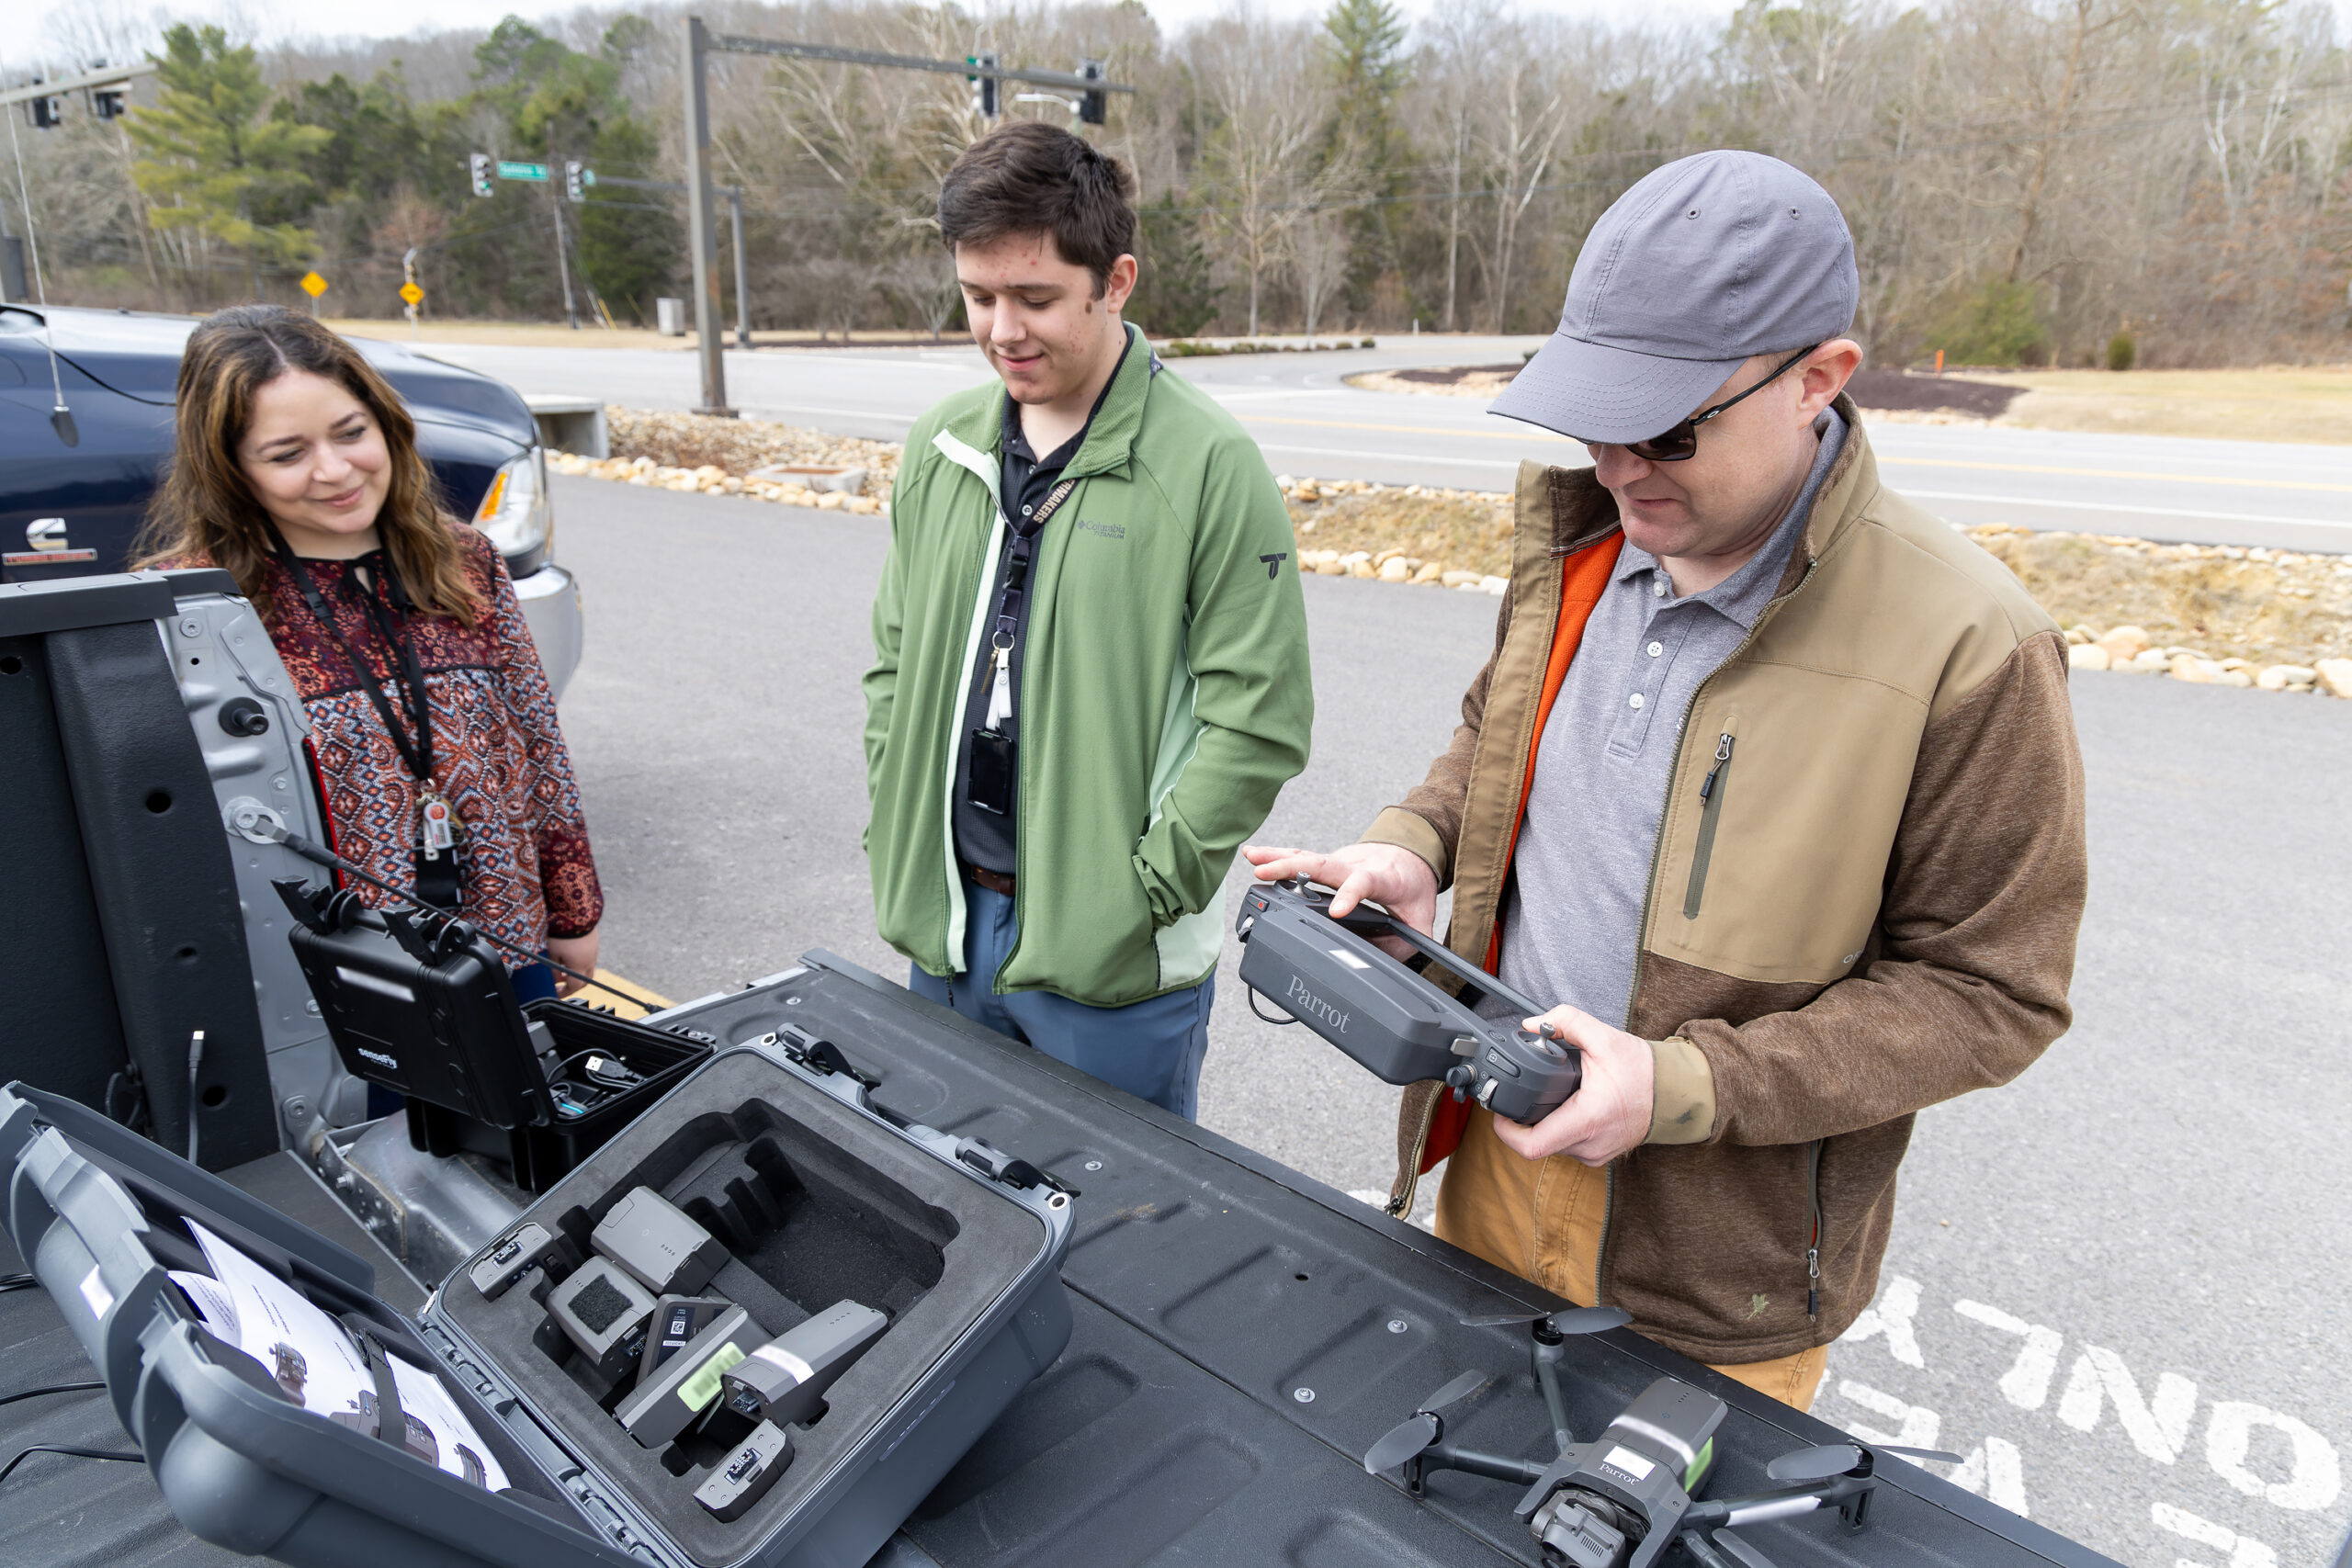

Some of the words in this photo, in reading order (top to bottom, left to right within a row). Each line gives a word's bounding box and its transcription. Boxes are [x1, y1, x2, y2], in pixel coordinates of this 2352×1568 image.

[1086, 520, 1125, 534] Columbia
[1286, 974, 1351, 1033] Parrot
[1840, 1275, 2342, 1511] ONLY
[1600, 1463, 1637, 1485] Parrot
